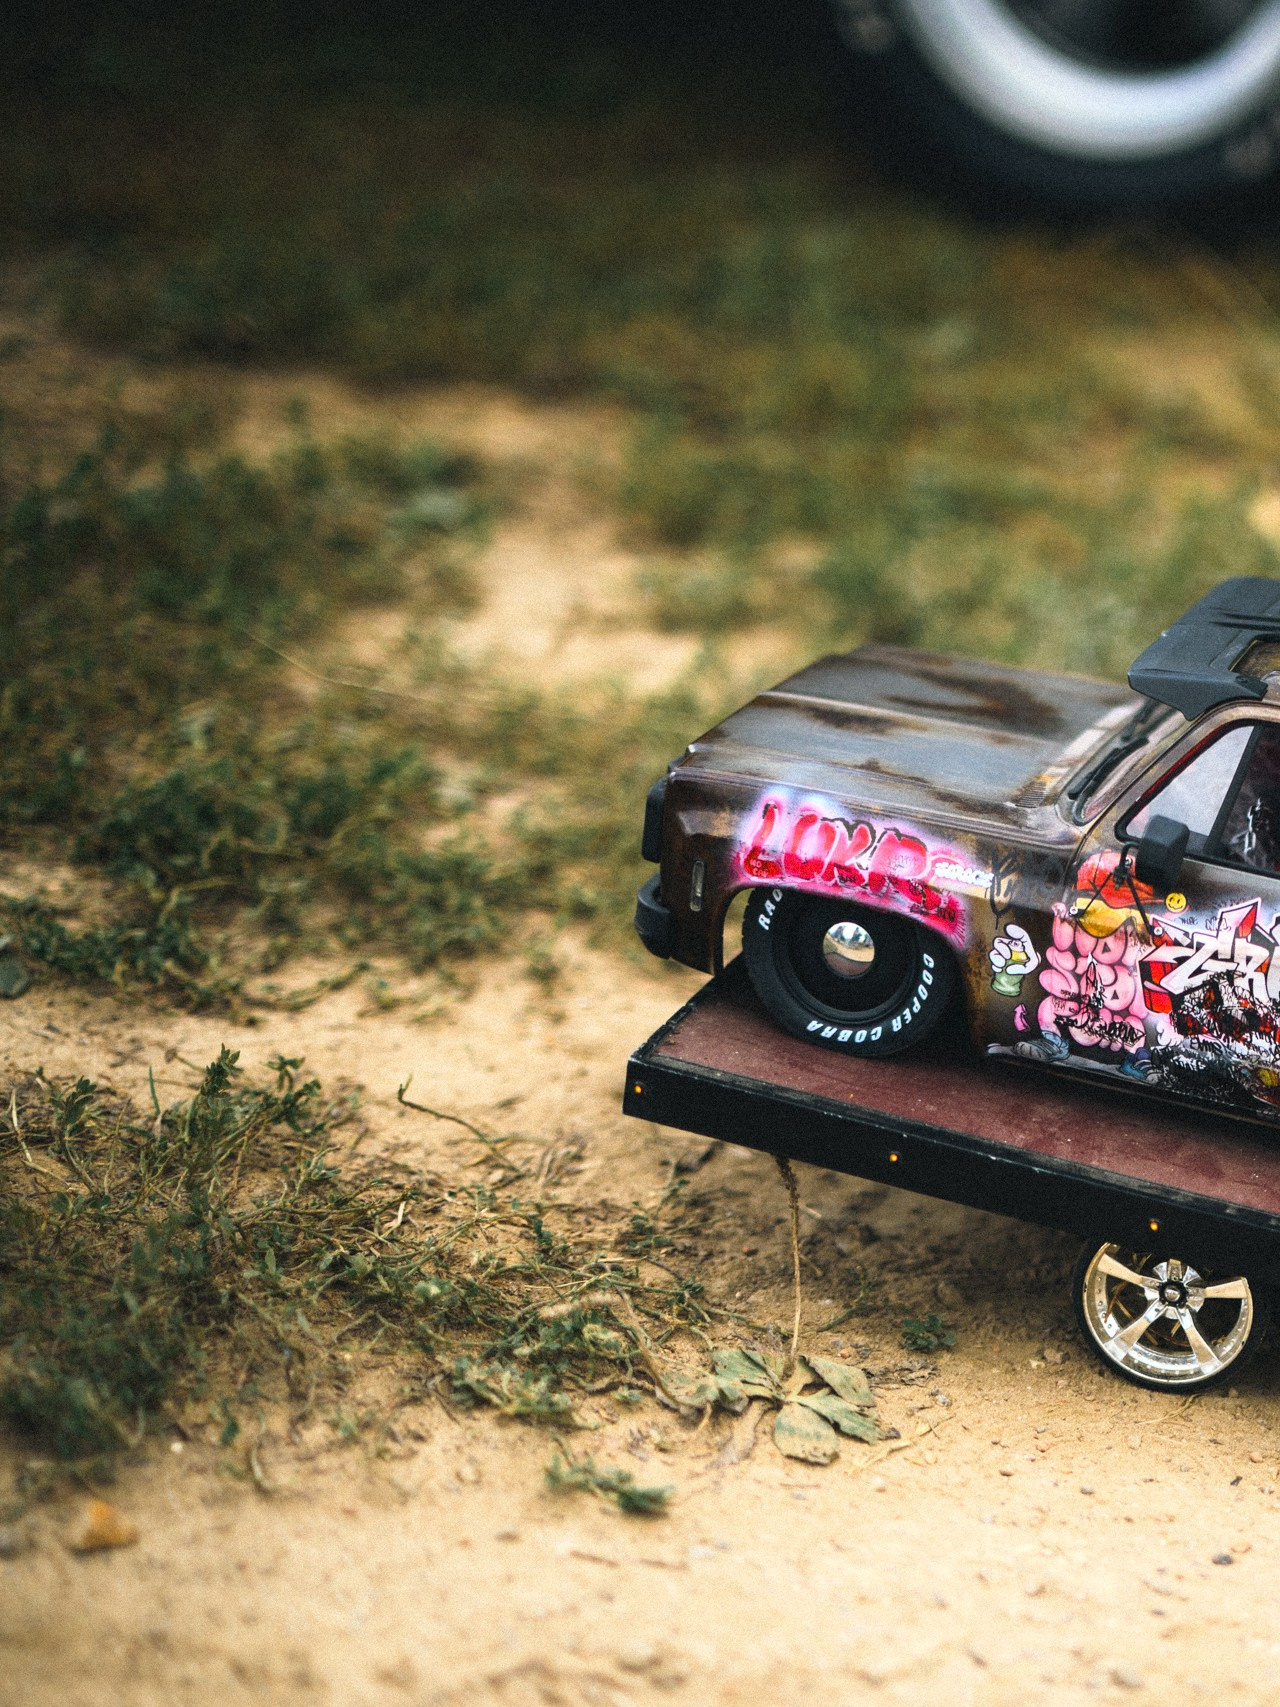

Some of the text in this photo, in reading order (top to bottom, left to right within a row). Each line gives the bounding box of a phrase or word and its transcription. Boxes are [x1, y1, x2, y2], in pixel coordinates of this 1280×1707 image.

[758, 888, 783, 931] RAD
[806, 953, 935, 1043] COOPER COBRA
